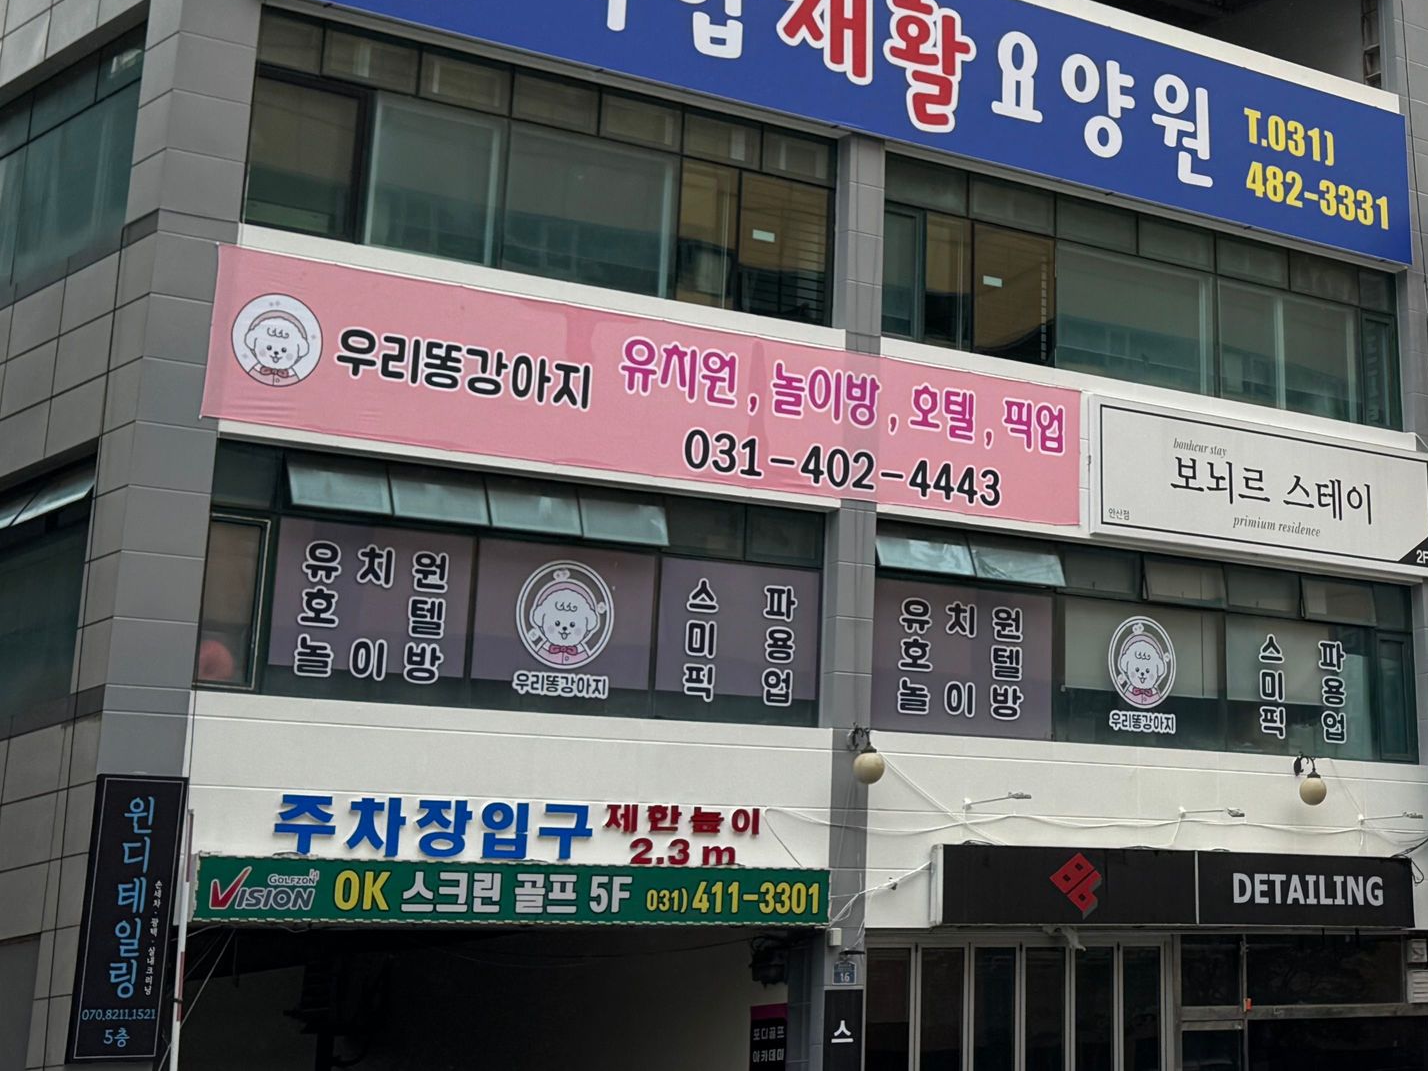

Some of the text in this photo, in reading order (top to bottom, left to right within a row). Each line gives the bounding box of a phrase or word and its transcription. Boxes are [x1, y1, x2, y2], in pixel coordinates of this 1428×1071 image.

[1245, 161, 1390, 231] 482-3331
[335, 326, 593, 411] 우리똥강아지
[1000, 396, 1066, 455] 픽업
[1173, 437, 1228, 459] bonheur stay
[682, 427, 1002, 509] 031-402-4443
[1170, 456, 1373, 526] 보뇌르 스테이
[1232, 514, 1321, 538] primium residence
[511, 671, 610, 699] 우리똥강아지
[1108, 710, 1177, 734] 우리똥강아지
[274, 793, 593, 861] 주차장입구
[603, 804, 761, 836] 제한높이
[629, 837, 738, 867] 2.3 m
[207, 866, 315, 912] VISION
[332, 869, 392, 912] OK
[400, 871, 502, 915] 스크린
[514, 872, 578, 915] 골프
[589, 874, 633, 915] 5F
[267, 871, 317, 888] GOLFZON
[1232, 872, 1384, 907] DETAILING
[109, 796, 156, 1000] 윈디테일링
[81, 1008, 156, 1022] 070.8211.1521
[103, 1027, 131, 1049] 5층
[830, 1018, 855, 1044] 스
